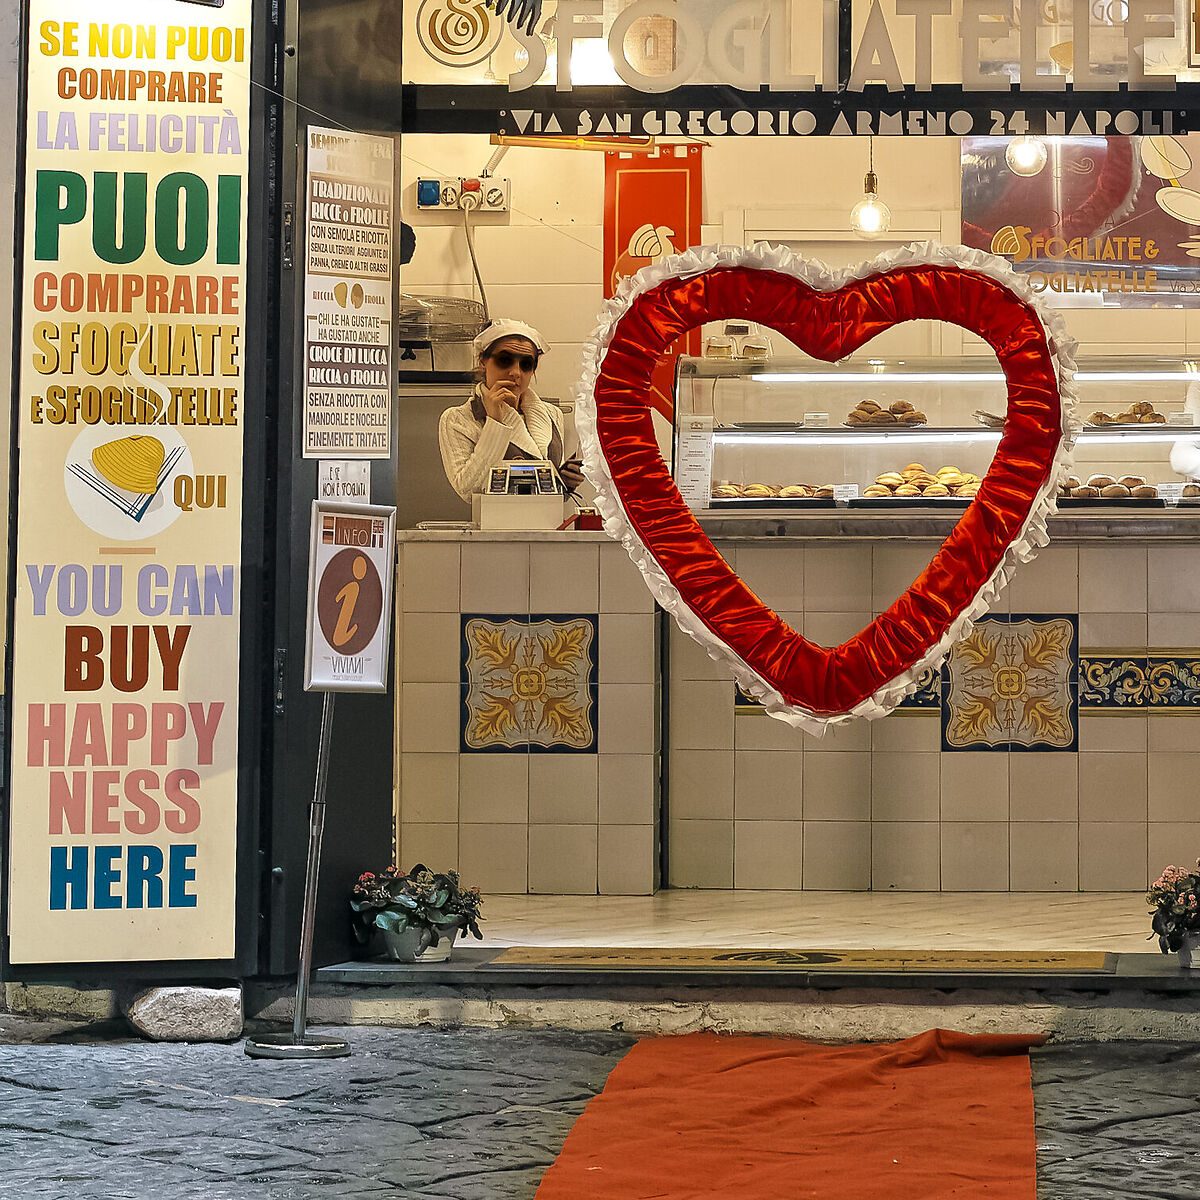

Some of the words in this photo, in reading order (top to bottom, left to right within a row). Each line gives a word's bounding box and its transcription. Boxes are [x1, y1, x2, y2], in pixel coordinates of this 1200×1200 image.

[39, 20, 78, 57] SE
[88, 22, 156, 60] NON
[168, 25, 245, 63] PUOI
[57, 66, 223, 104] COMPRARE
[36, 110, 79, 151] LA
[88, 107, 242, 155] FELICITÀ
[510, 109, 563, 134] VIA
[577, 109, 632, 135] SAN
[642, 109, 817, 135] GREGORIO
[830, 109, 976, 136] ARMENO
[989, 109, 1030, 136] 24
[1045, 109, 1173, 136] NAPOLI
[34, 169, 242, 265] PUOI
[311, 201, 342, 222] RICCE
[350, 206, 389, 227] FROLLE
[311, 225, 326, 239] CON
[328, 226, 355, 242] SEMOLA
[356, 230, 360, 243] E
[361, 231, 389, 246] RICOTTA
[310, 242, 328, 254] SENZA
[329, 244, 355, 257] ULTERIORI
[357, 246, 382, 259] AGGIUNTE
[331, 258, 349, 270] CREME
[354, 261, 369, 272] ALTRI
[369, 262, 388, 273] GRASSI
[33, 271, 239, 315] COMPRARE
[1018, 270, 1158, 294] OGLIATELLE
[364, 294, 386, 305] FROLLA
[318, 312, 330, 325] CHI
[331, 314, 340, 326] LE
[340, 314, 351, 327] HA
[351, 315, 380, 329] GUSTATE
[32, 320, 241, 377] SFOGLIATE
[318, 328, 328, 341] HA
[328, 329, 357, 342] GUSTATO
[358, 330, 380, 343] ANCHE
[309, 345, 343, 363] CROCE
[343, 347, 357, 364] DI
[357, 347, 388, 366] LUCCA
[308, 367, 342, 384] RICCIA
[350, 369, 388, 386] FROLLA
[30, 396, 44, 425] E
[46, 385, 239, 426] SFOGLIATELLE
[308, 392, 335, 407] SENZA
[336, 393, 369, 408] RICOTTA
[370, 394, 387, 409] CON
[308, 411, 349, 426] MANDORLE
[349, 412, 355, 426] E
[356, 412, 387, 427] NOCELLE
[308, 431, 354, 447] FINEMENTE
[355, 432, 387, 447] TRITATE
[172, 474, 227, 512] QUI
[337, 528, 369, 547] INFO
[25, 563, 124, 617] YOU
[136, 564, 234, 617] CAN
[64, 625, 192, 692] BUY
[27, 702, 225, 767] HAPPY
[48, 768, 201, 836] NESS
[49, 844, 198, 910] HERE
